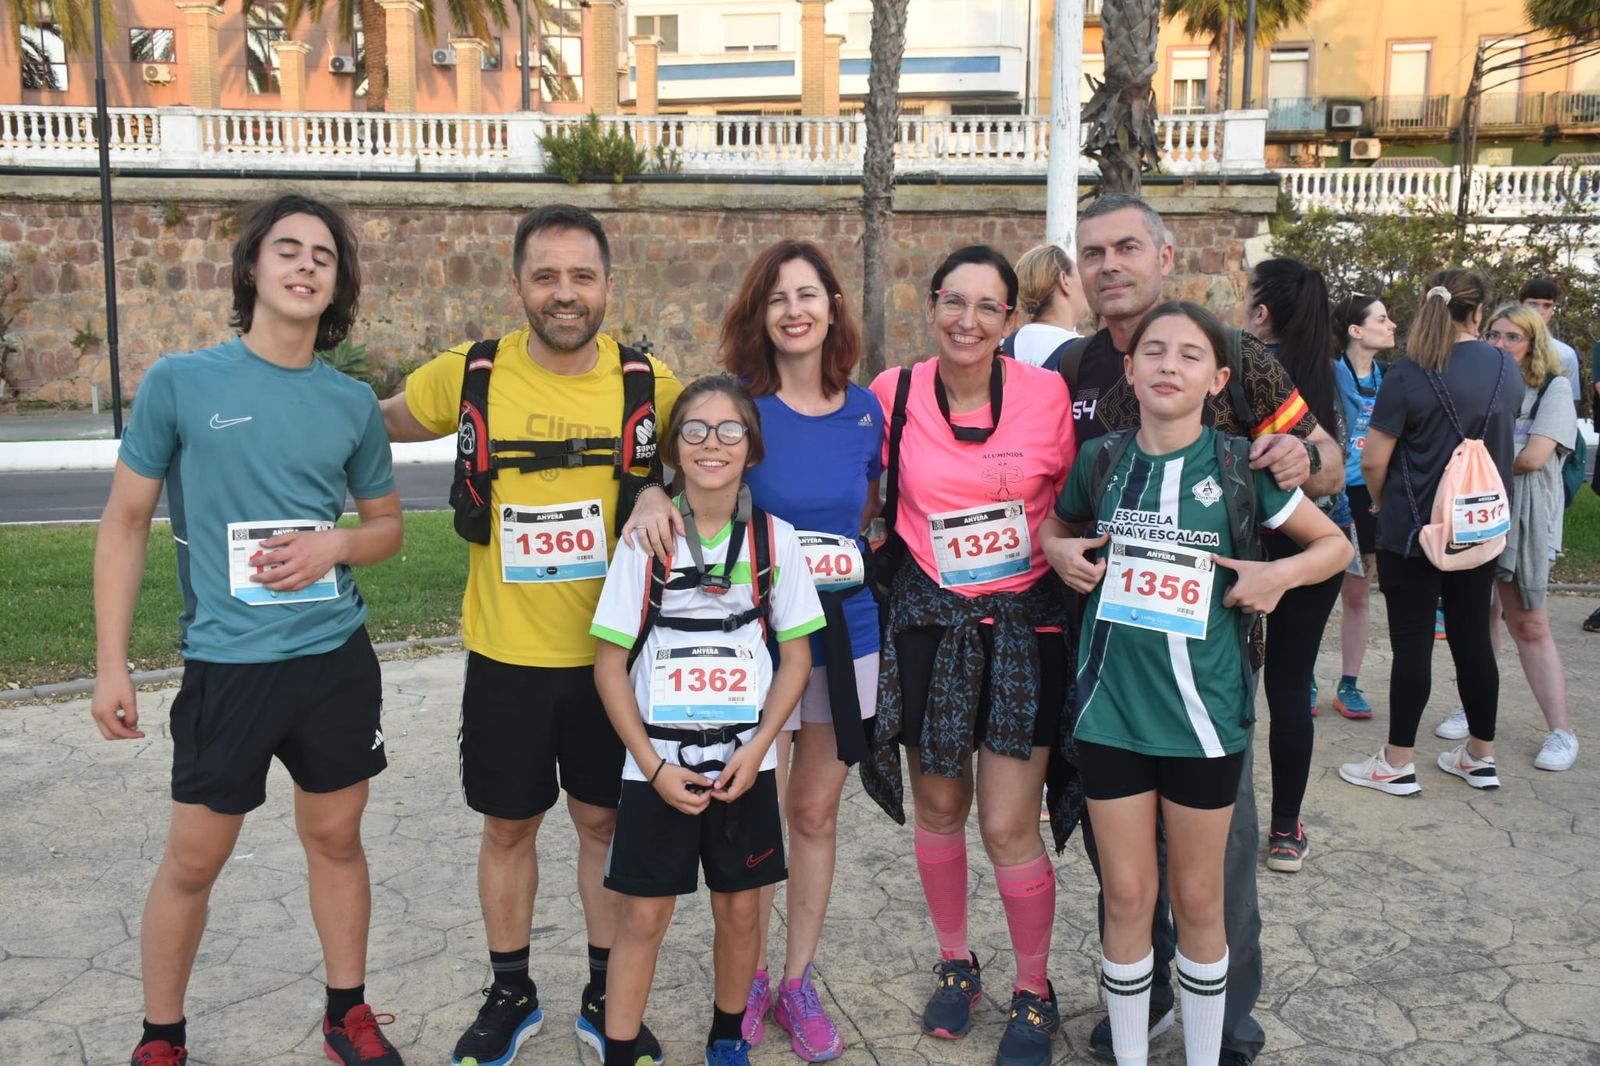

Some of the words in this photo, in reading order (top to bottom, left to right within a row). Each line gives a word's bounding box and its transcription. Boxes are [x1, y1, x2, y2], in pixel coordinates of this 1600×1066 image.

[525, 413, 611, 439] Clima
[1114, 511, 1173, 525] ESCUELA
[516, 529, 595, 555] 1360
[947, 527, 1020, 559] 1323
[1149, 529, 1219, 545] ESCALADA
[1146, 550, 1176, 561] ANYERA
[1121, 568, 1201, 605] 1356
[668, 668, 747, 692] 1362
